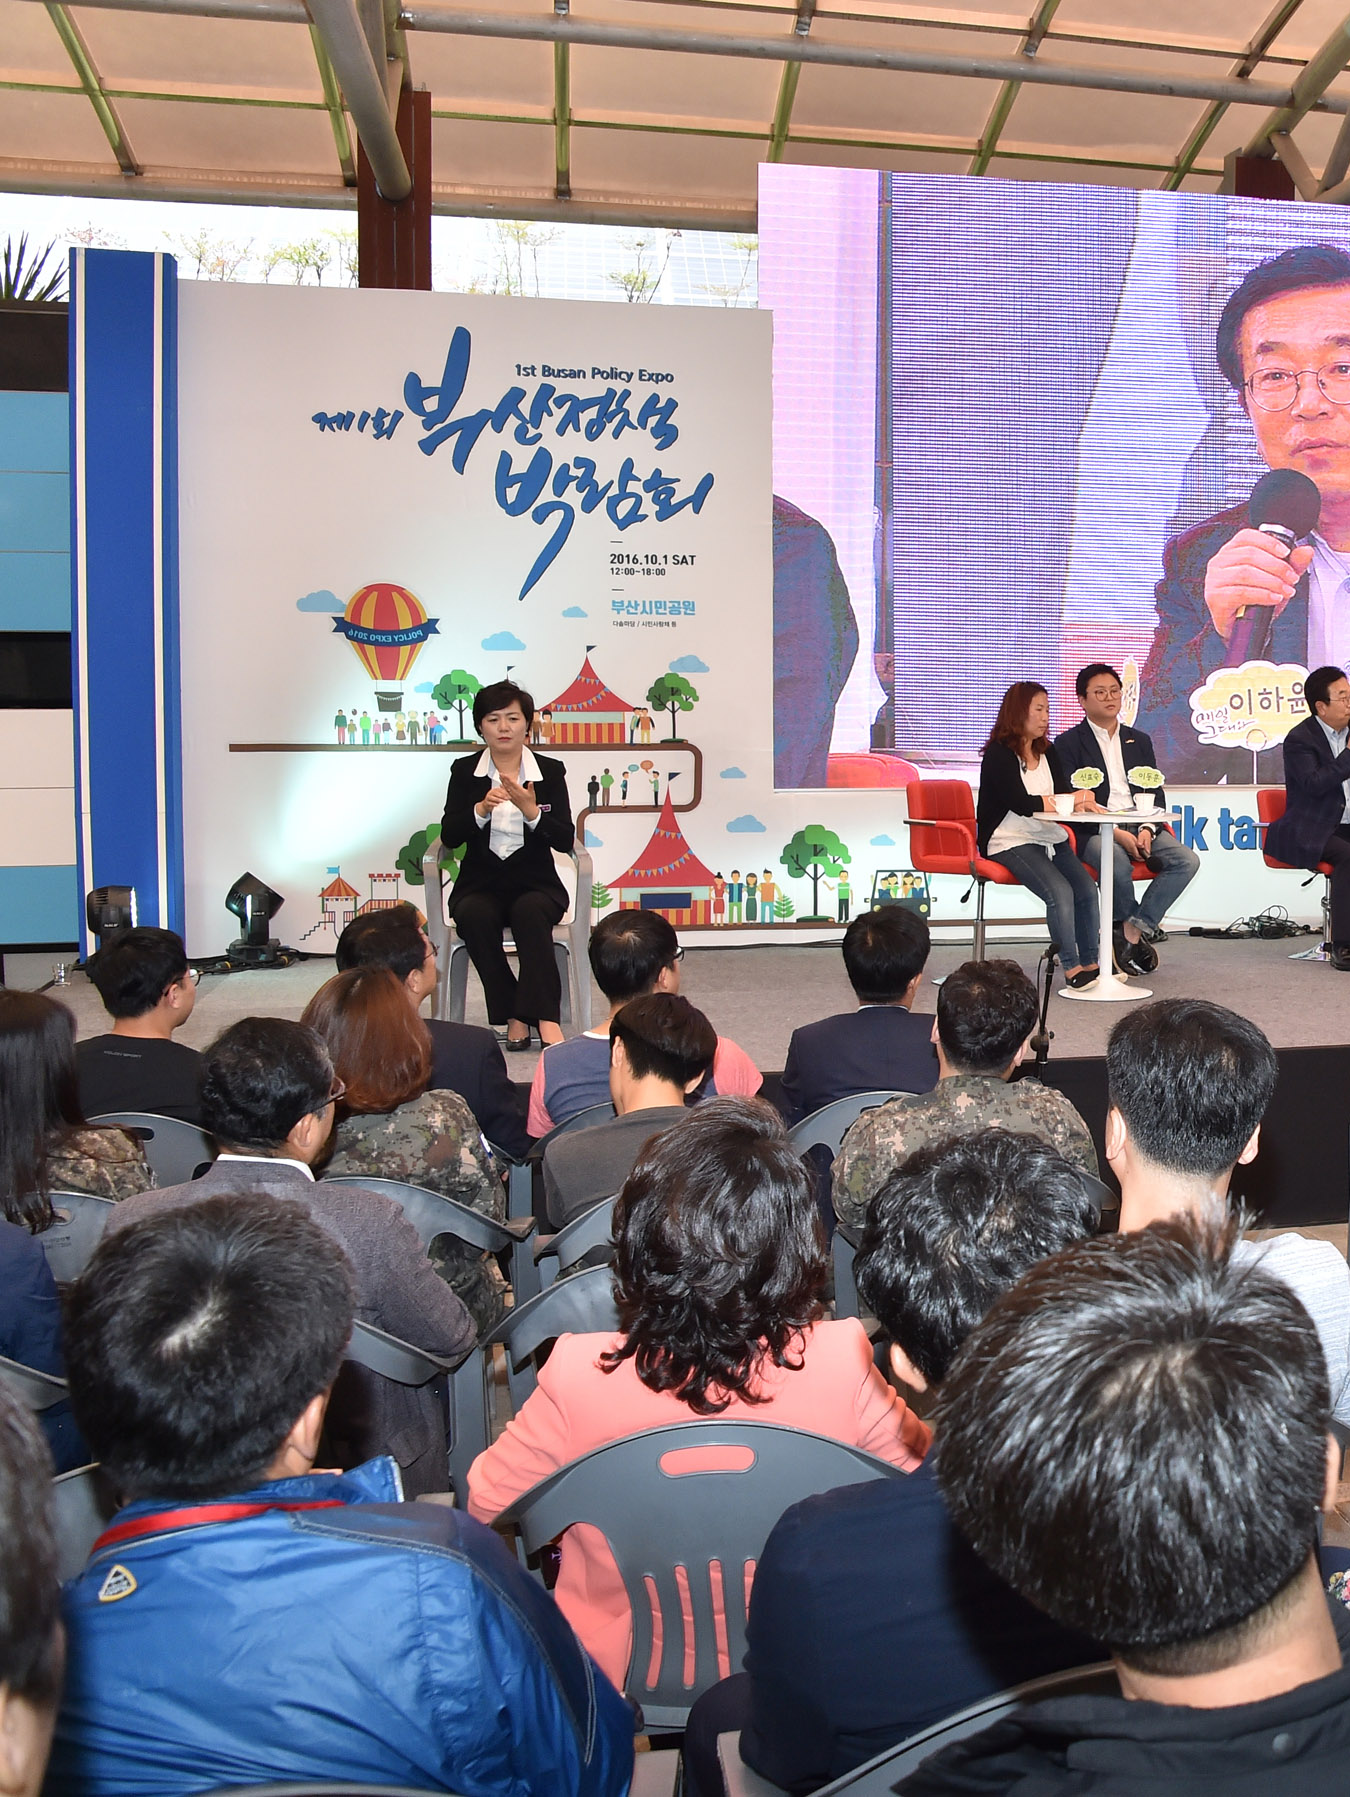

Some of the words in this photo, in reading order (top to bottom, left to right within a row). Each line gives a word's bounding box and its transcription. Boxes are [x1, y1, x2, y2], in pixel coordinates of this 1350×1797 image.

[515, 363, 537, 377] 1st
[541, 364, 586, 379] Busan
[591, 366, 634, 383] Policy
[638, 369, 674, 384] Expo
[311, 408, 404, 440] 제1회
[495, 446, 715, 601] 박람회
[610, 553, 668, 566] 2016.10.1
[672, 555, 696, 566] SAT
[610, 567, 666, 576] 12:00~18:00
[611, 600, 696, 616] 부산시민공원
[1230, 682, 1307, 715] 이하윤
